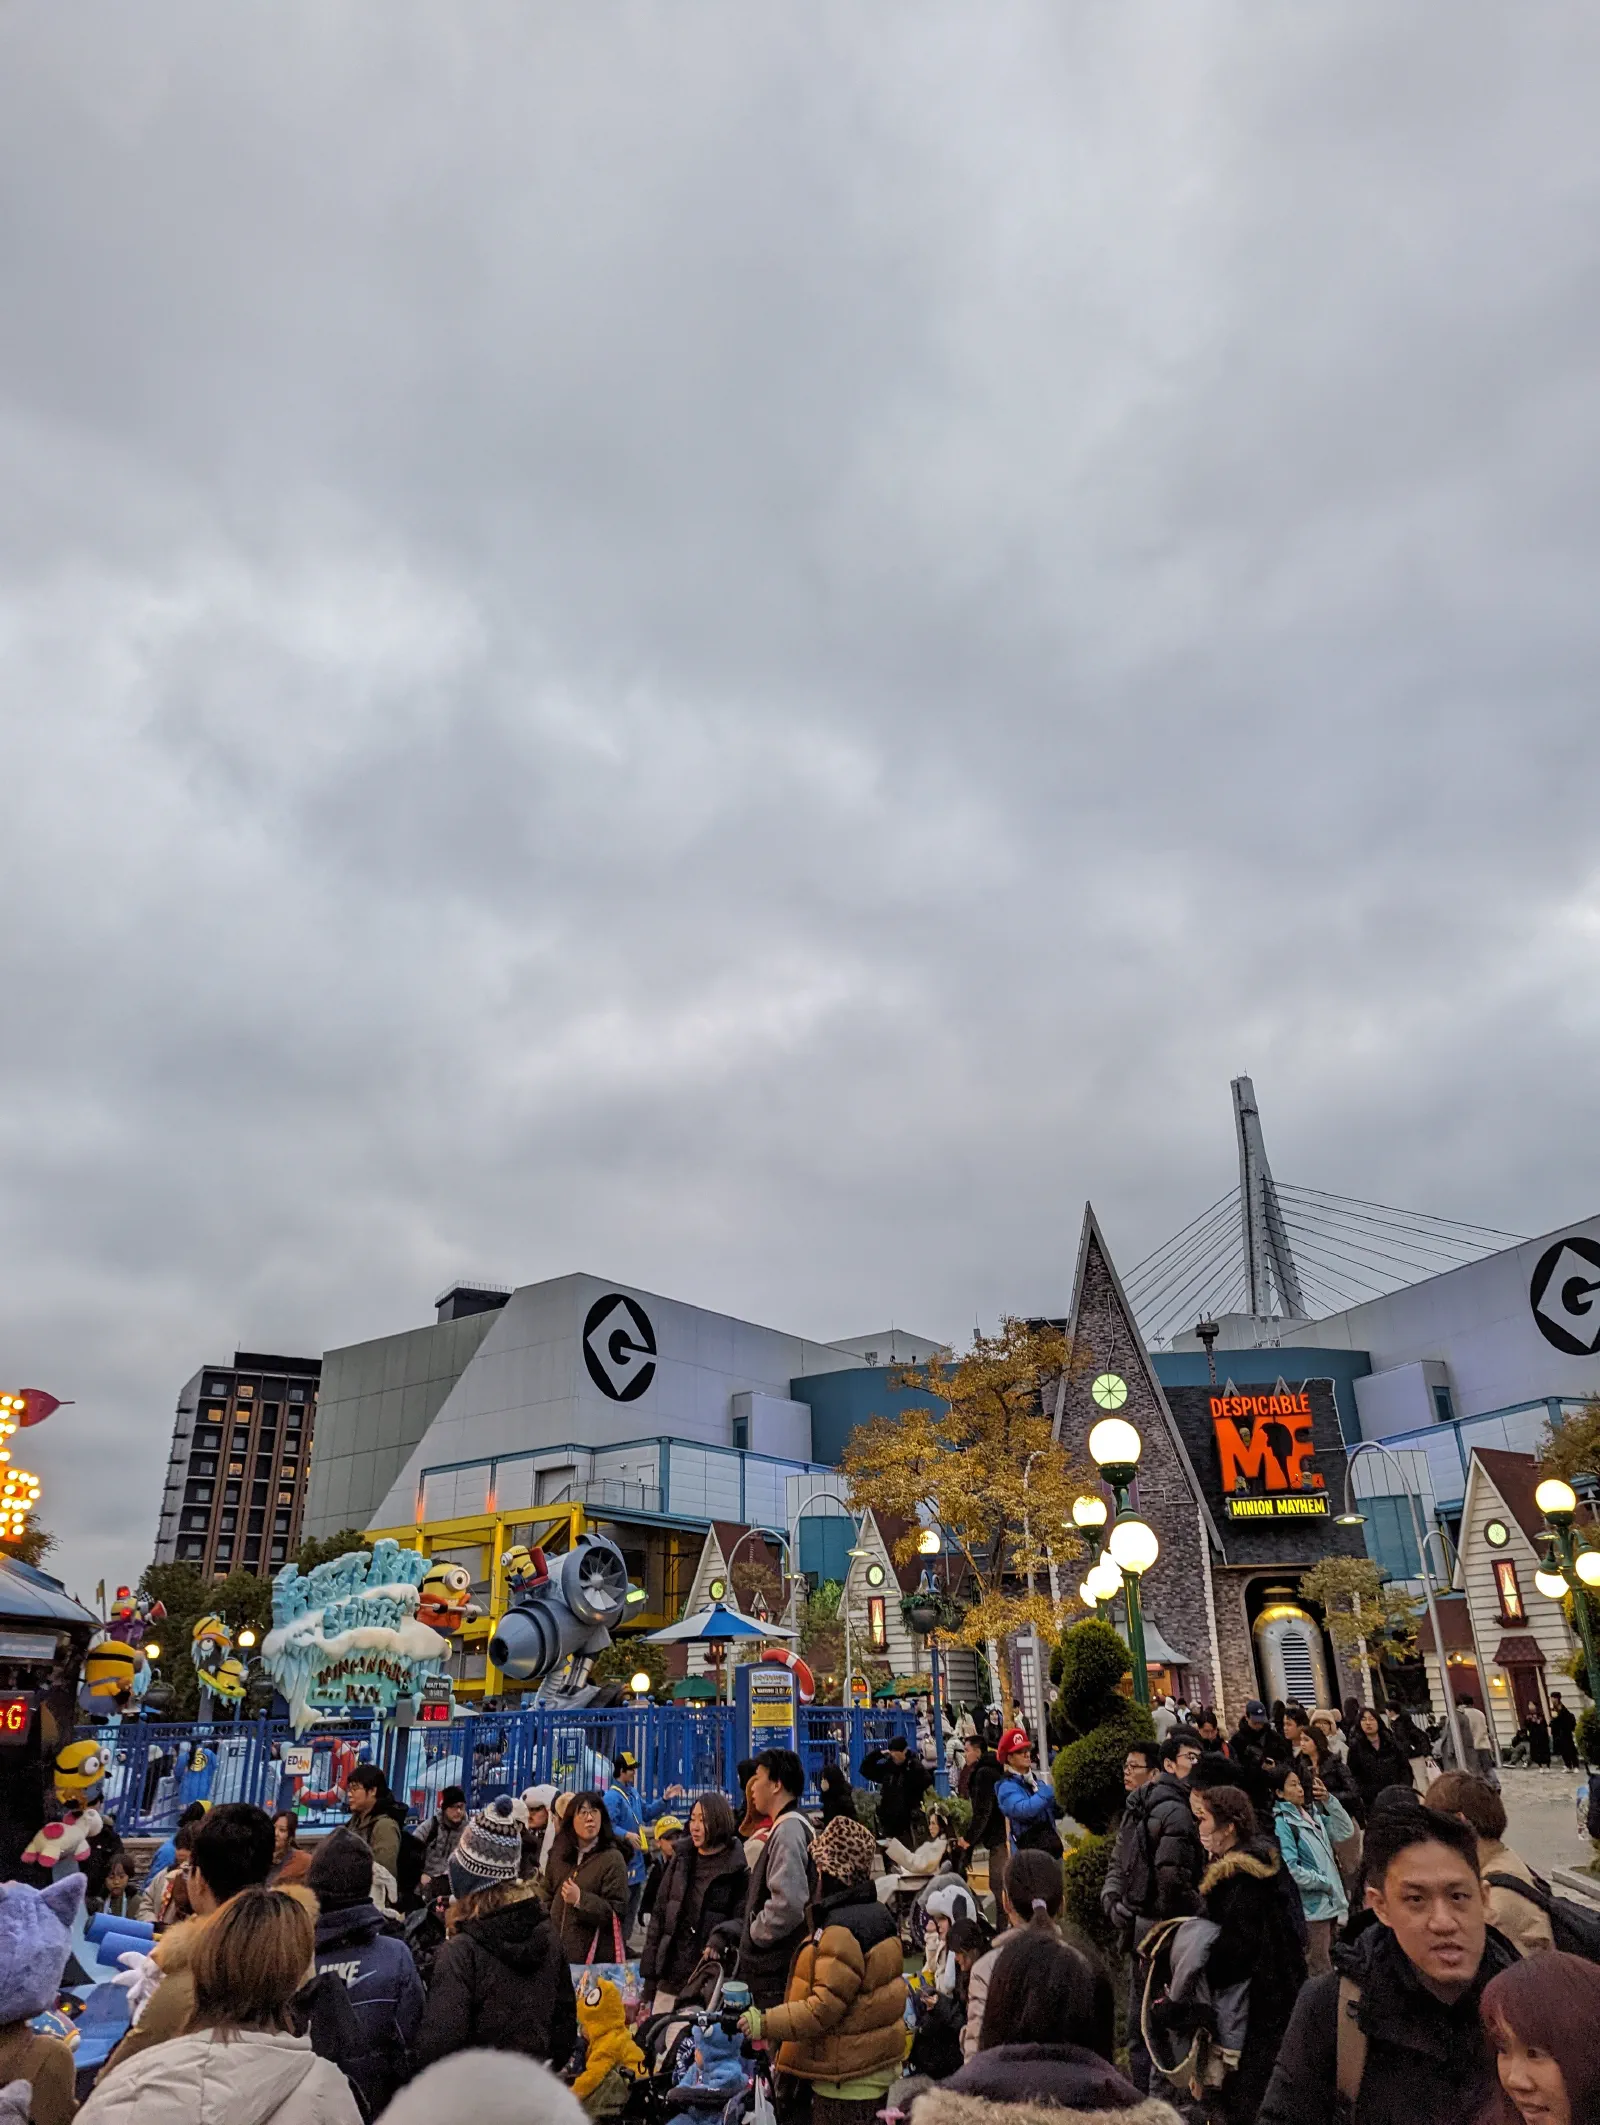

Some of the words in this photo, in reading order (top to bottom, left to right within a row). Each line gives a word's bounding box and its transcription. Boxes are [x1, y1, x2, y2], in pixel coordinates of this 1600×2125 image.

[1209, 1393, 1311, 1418] DESPICABLE
[1213, 1413, 1325, 1492] ME
[1232, 1500, 1273, 1515] MINION
[1276, 1498, 1325, 1514] MAYHEM
[0, 1705, 22, 1730] G
[287, 1755, 310, 1770] EDION
